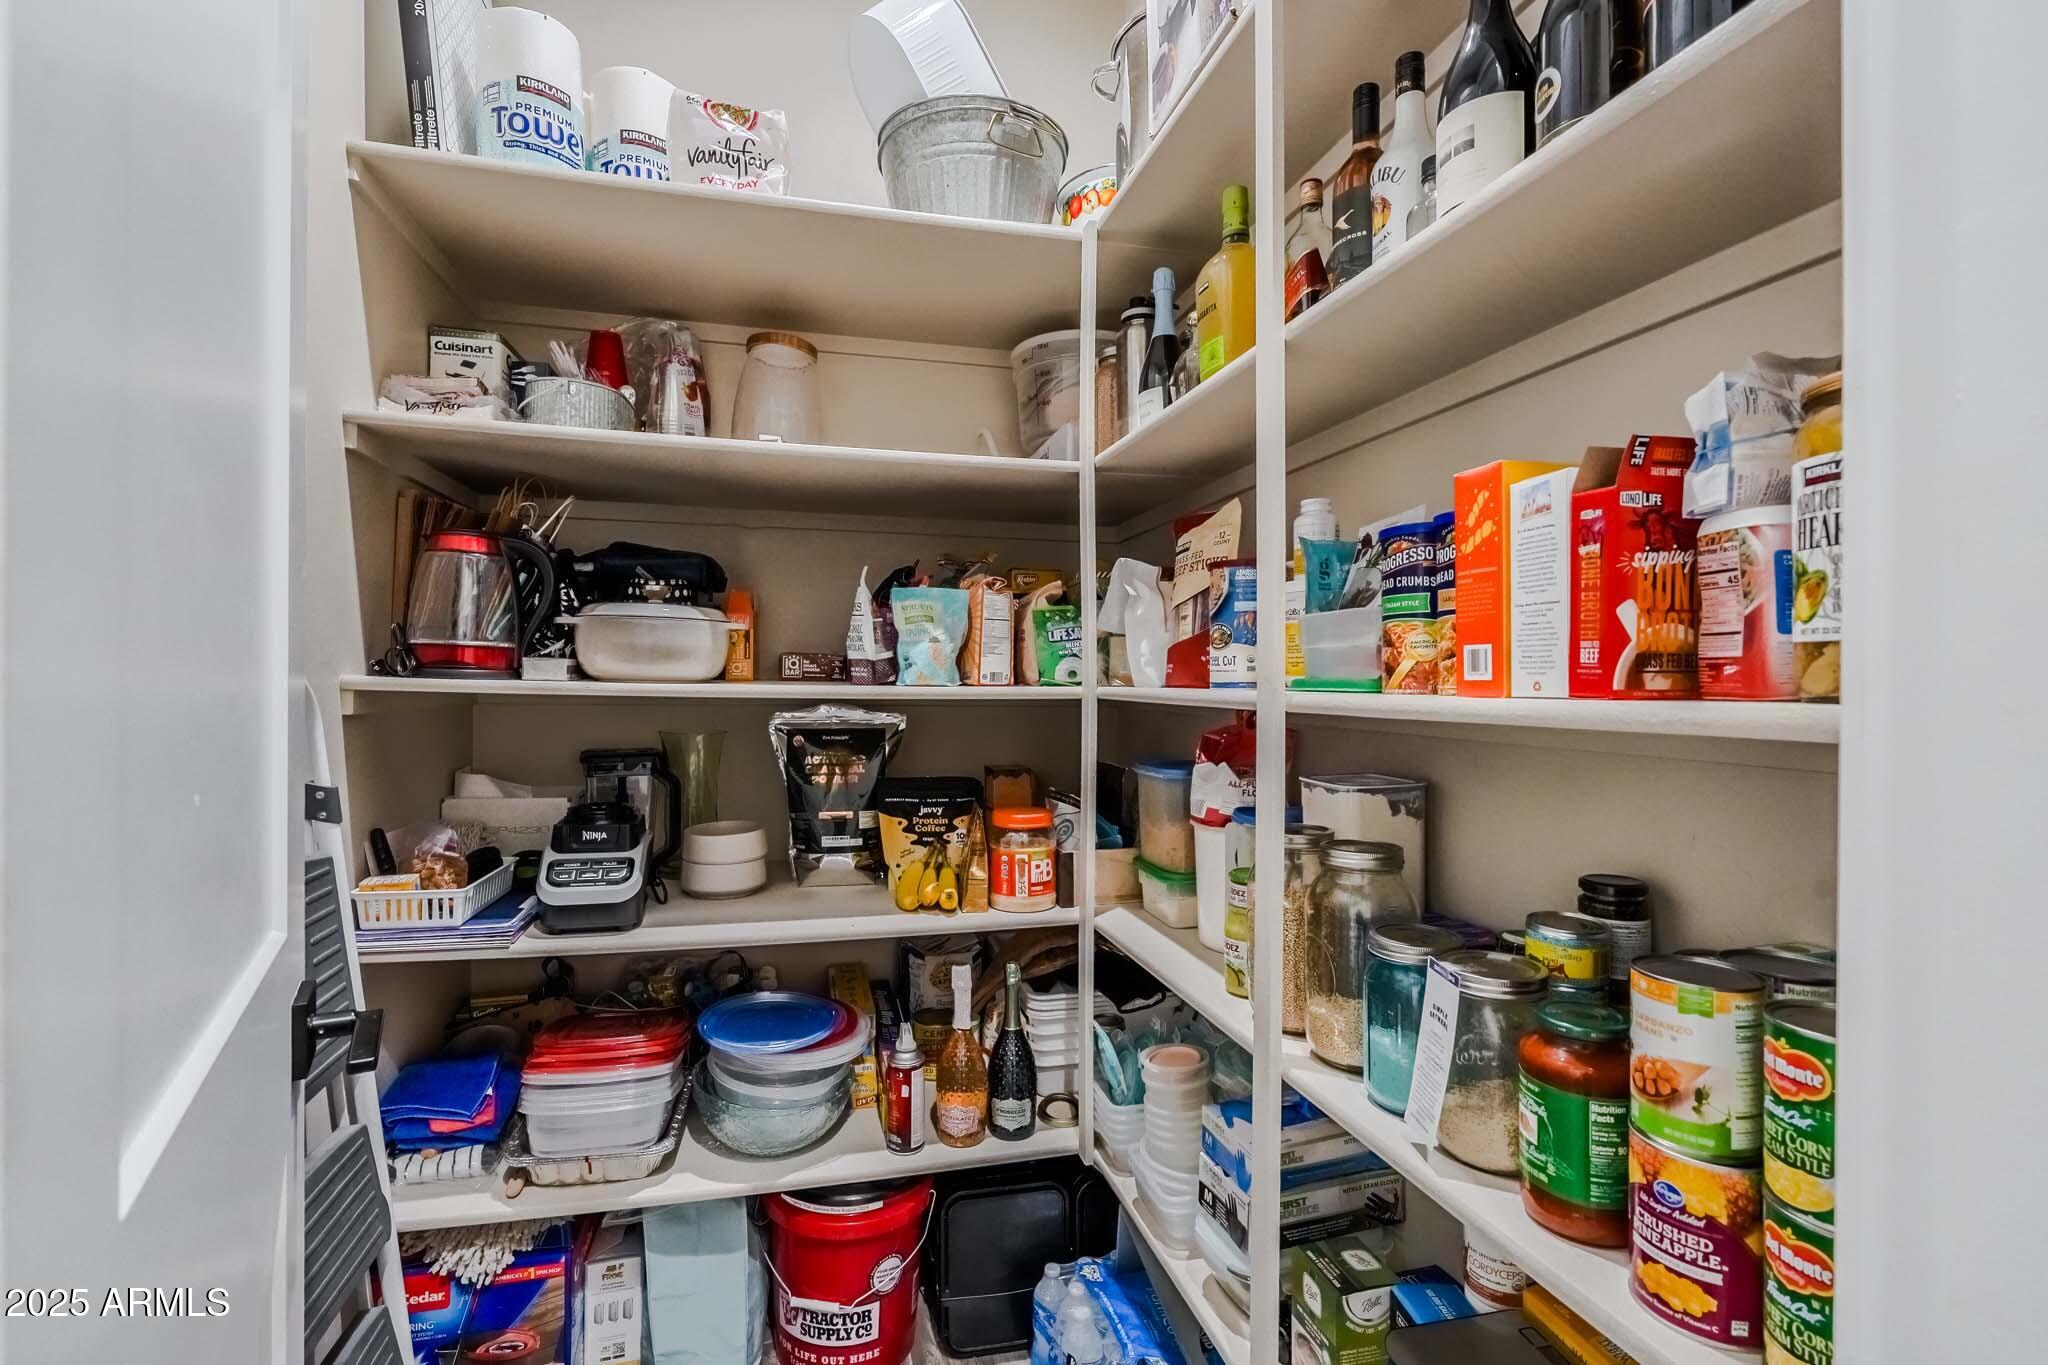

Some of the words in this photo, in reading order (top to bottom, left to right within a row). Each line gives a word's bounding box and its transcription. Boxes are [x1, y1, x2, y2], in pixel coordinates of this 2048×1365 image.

[519, 77, 570, 103] KIRKLAND
[515, 102, 573, 130] PREMIUM
[414, 112, 424, 148] iltrete
[700, 175, 758, 190] EVERYDAY
[434, 340, 494, 354] Cuisinart
[1631, 437, 1650, 465] LIFE
[1219, 531, 1226, 539] 12
[1719, 544, 1738, 552] Facts
[1382, 546, 1434, 572] ROGRESSO
[1631, 545, 1695, 573] sipping
[1382, 578, 1394, 590] EAD
[1396, 577, 1437, 588] CRUMBS
[1727, 575, 1740, 585] 45
[785, 656, 799, 670] IQ
[1580, 648, 1599, 663] BEEF
[918, 805, 943, 816] javvy
[912, 816, 949, 825] Protein
[582, 830, 608, 842] NINJA
[1775, 1058, 1825, 1089] Monte
[857, 1096, 876, 1106] GLAD
[1592, 1104, 1626, 1114] Nutrition
[1592, 1113, 1615, 1123] Facts
[1205, 1132, 1213, 1148] M
[1785, 1127, 1831, 1161] CORN
[1786, 1148, 1831, 1178] STYLE
[1364, 1181, 1379, 1192] EXAM
[1204, 1189, 1213, 1205] M
[1650, 1196, 1673, 1215] Sugar
[1672, 1211, 1707, 1228] Added
[1635, 1207, 1714, 1254] CRUSHED
[1468, 1254, 1524, 1281] CORDYCEPS
[1780, 1244, 1833, 1285] Monte
[495, 1273, 523, 1281] AMERICA'S
[602, 1272, 623, 1281] FROG
[801, 1309, 872, 1327] TRACTOR
[801, 1321, 854, 1341] SUPPLY
[1712, 1326, 1719, 1334] C
[795, 1347, 817, 1363] LIFE
[821, 1352, 845, 1365] OUT
[850, 1347, 881, 1363] HERE
